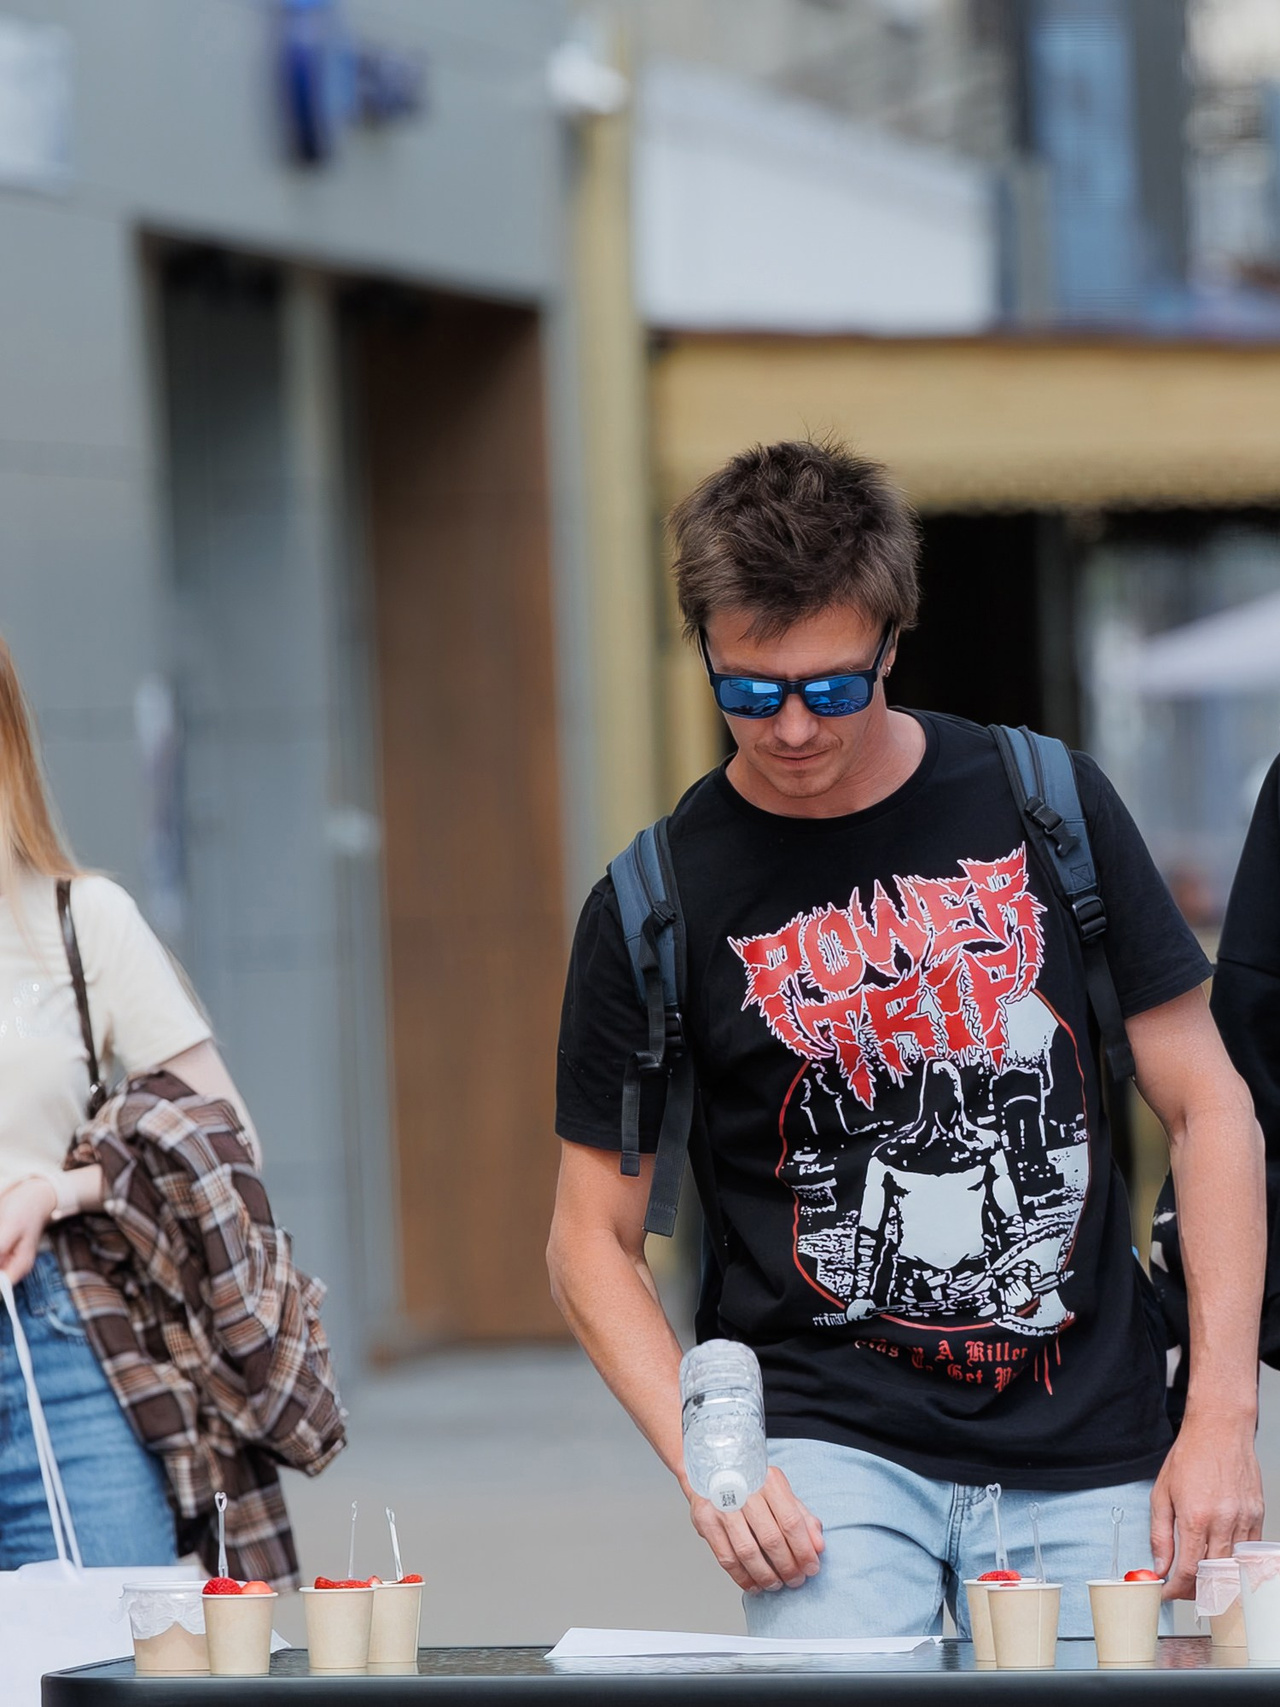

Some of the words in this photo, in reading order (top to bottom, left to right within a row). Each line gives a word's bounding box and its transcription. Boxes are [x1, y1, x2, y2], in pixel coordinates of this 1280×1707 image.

[728, 841, 1047, 1058] POWER
[793, 937, 1020, 1111] TRIP
[934, 1339, 954, 1361] A
[965, 1341, 1028, 1367] Killer
[947, 1363, 983, 1384] Get
